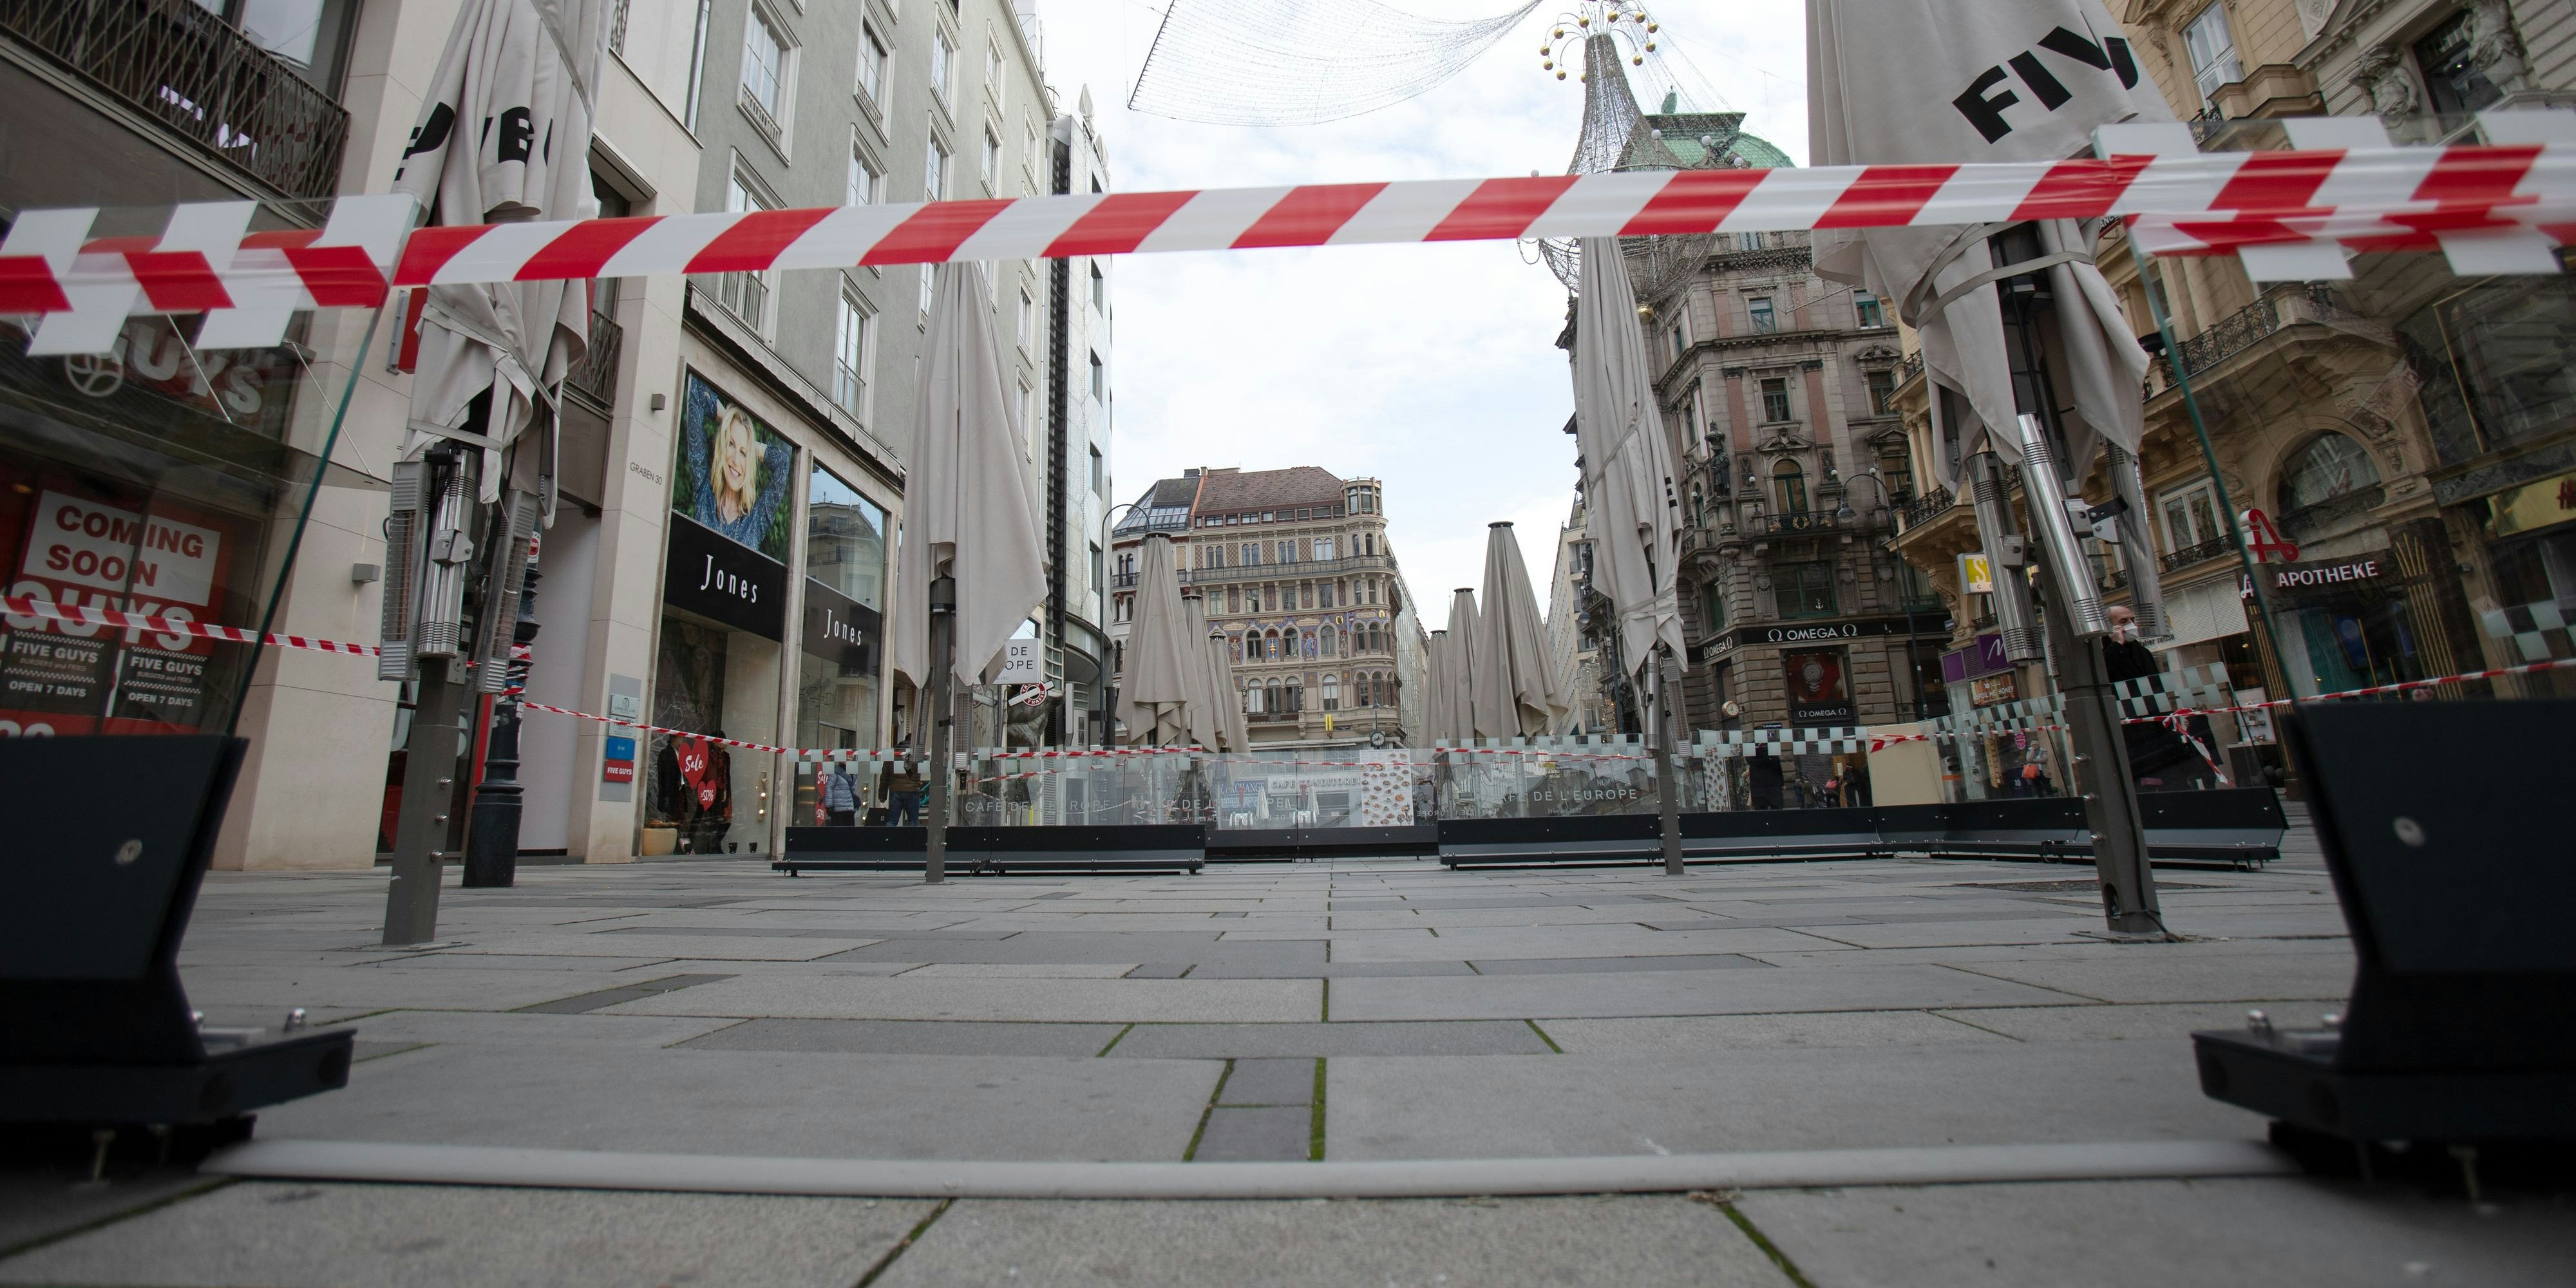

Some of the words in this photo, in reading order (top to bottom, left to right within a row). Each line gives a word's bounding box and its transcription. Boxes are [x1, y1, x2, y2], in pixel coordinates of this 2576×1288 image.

[113, 322, 262, 414] UYS
[630, 462, 654, 481] GRABEN
[655, 475, 662, 485] 30
[56, 506, 204, 558] COMING
[46, 544, 158, 586] SOON
[700, 554, 758, 603] Jones
[2278, 560, 2379, 588] APOTHEKE
[824, 609, 862, 646] Jones
[1787, 627, 1838, 641] OMEGA
[13, 641, 50, 658] FIVE
[55, 647, 99, 663] GUYS
[1010, 647, 1028, 656] DE
[1709, 641, 1726, 657] OMEGA
[68, 663, 87, 672] FRIES
[130, 656, 163, 670] FIVE
[166, 661, 203, 676] GUYS
[9, 681, 42, 693] OPEN
[46, 685, 53, 694] 7
[57, 686, 86, 697] DAYS
[1975, 692, 1989, 700] SPOIL
[1998, 686, 2014, 695] HONEY
[129, 692, 156, 704] OPEN
[159, 696, 166, 704] 7
[168, 696, 193, 706] DAYS
[685, 754, 703, 772] Sale
[701, 790, 714, 801] -50%
[1182, 799, 1201, 809] DE
[1534, 791, 1553, 802] DE
[1560, 789, 1638, 801] L'EUROPE
